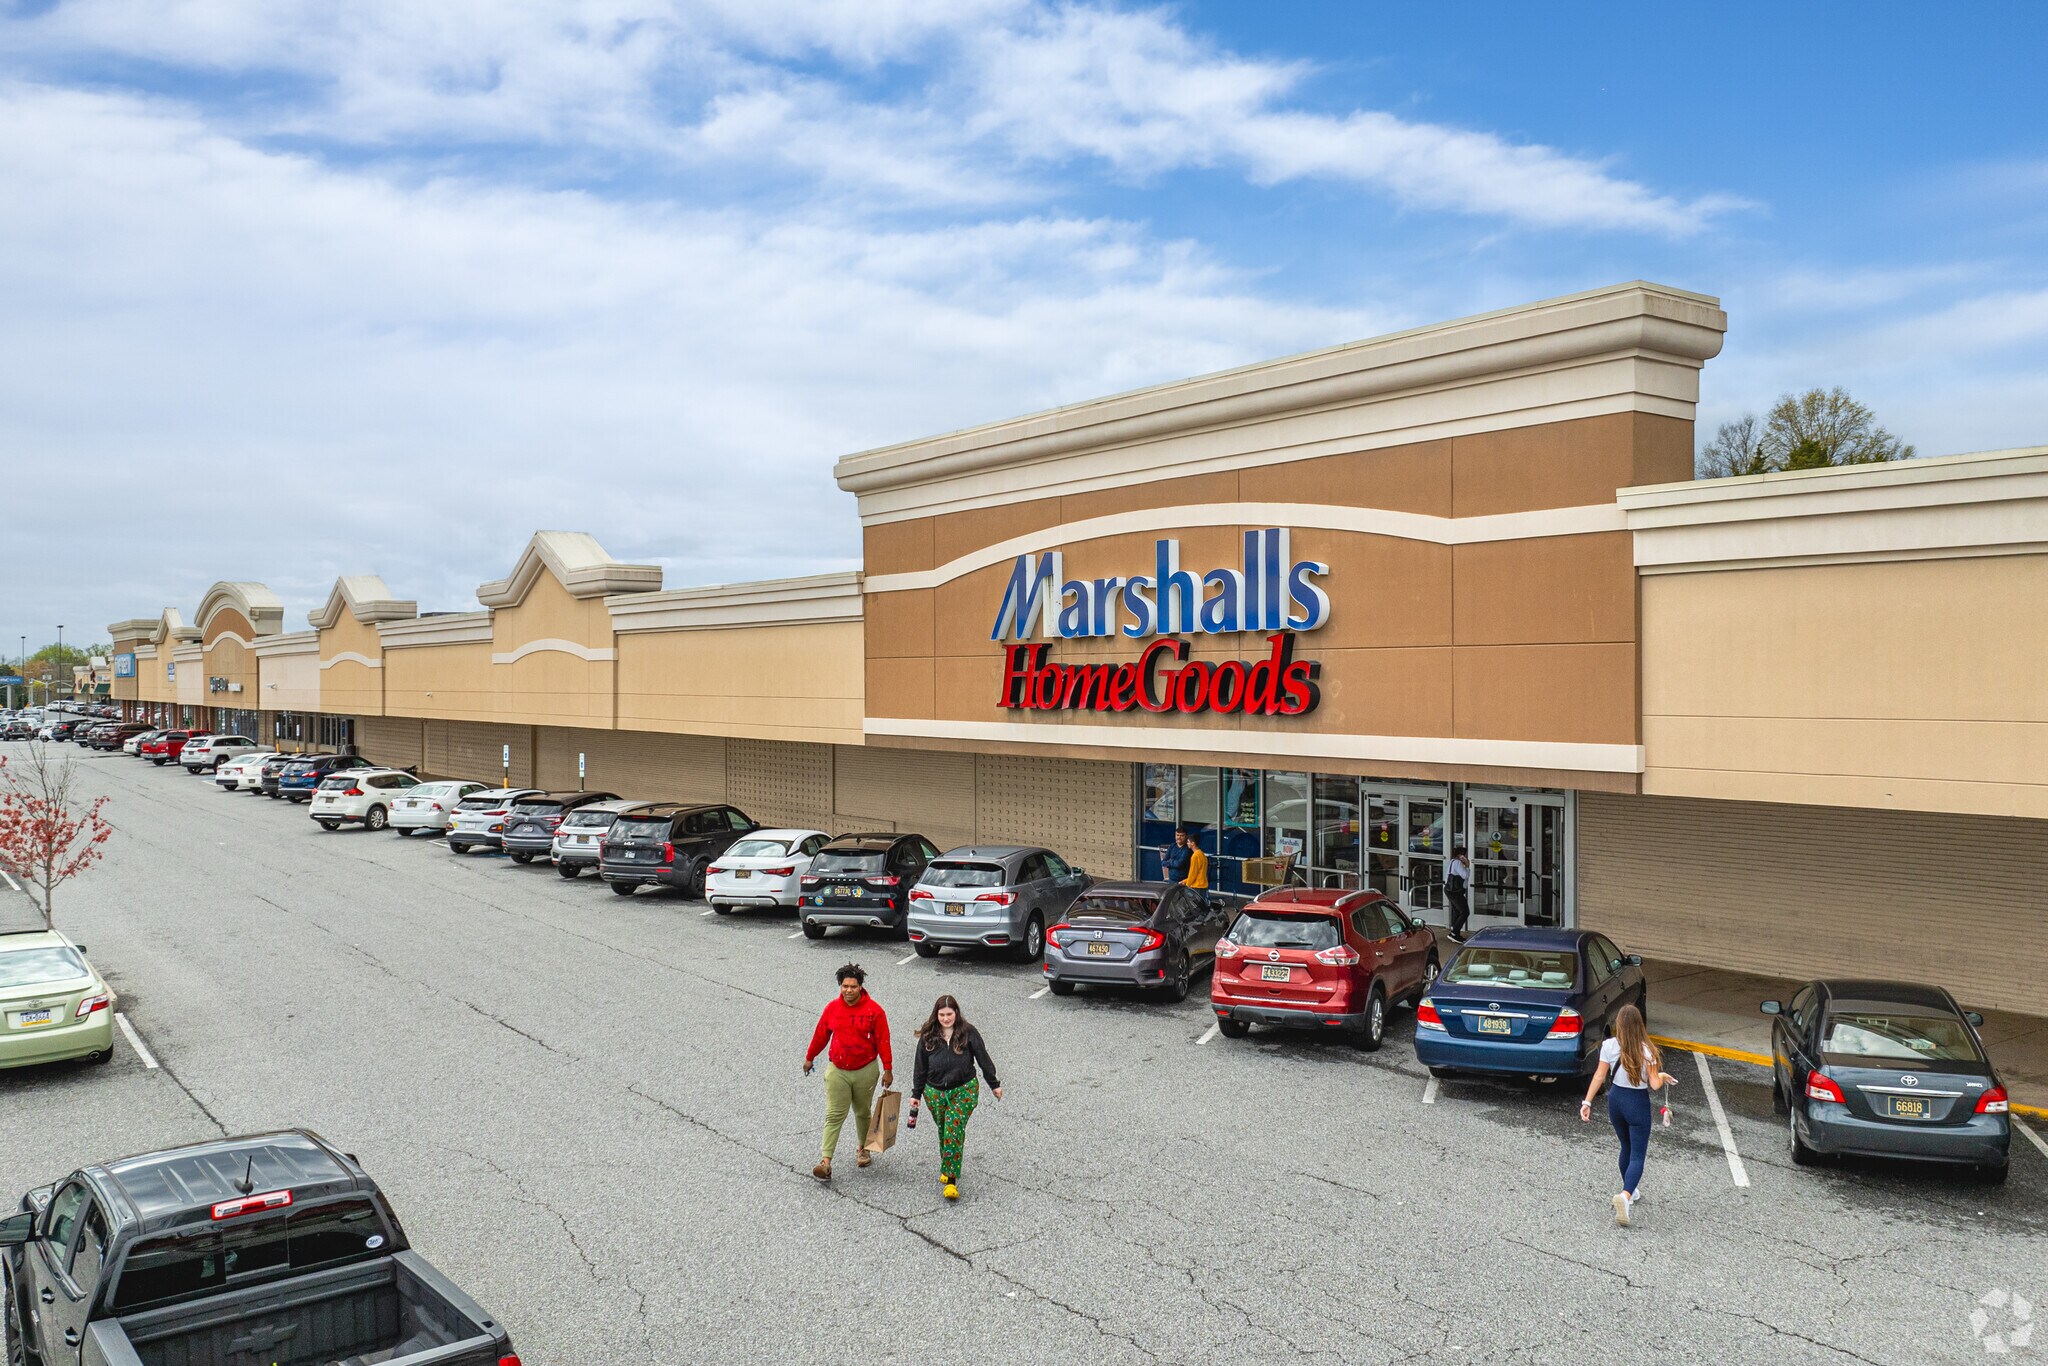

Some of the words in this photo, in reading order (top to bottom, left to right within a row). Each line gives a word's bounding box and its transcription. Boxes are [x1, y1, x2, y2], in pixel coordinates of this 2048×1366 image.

[990, 528, 1330, 639] Marshalls
[996, 633, 1322, 716] HomeGoods
[1482, 1018, 1507, 1029] 481939
[1896, 1101, 1923, 1113] 66818
